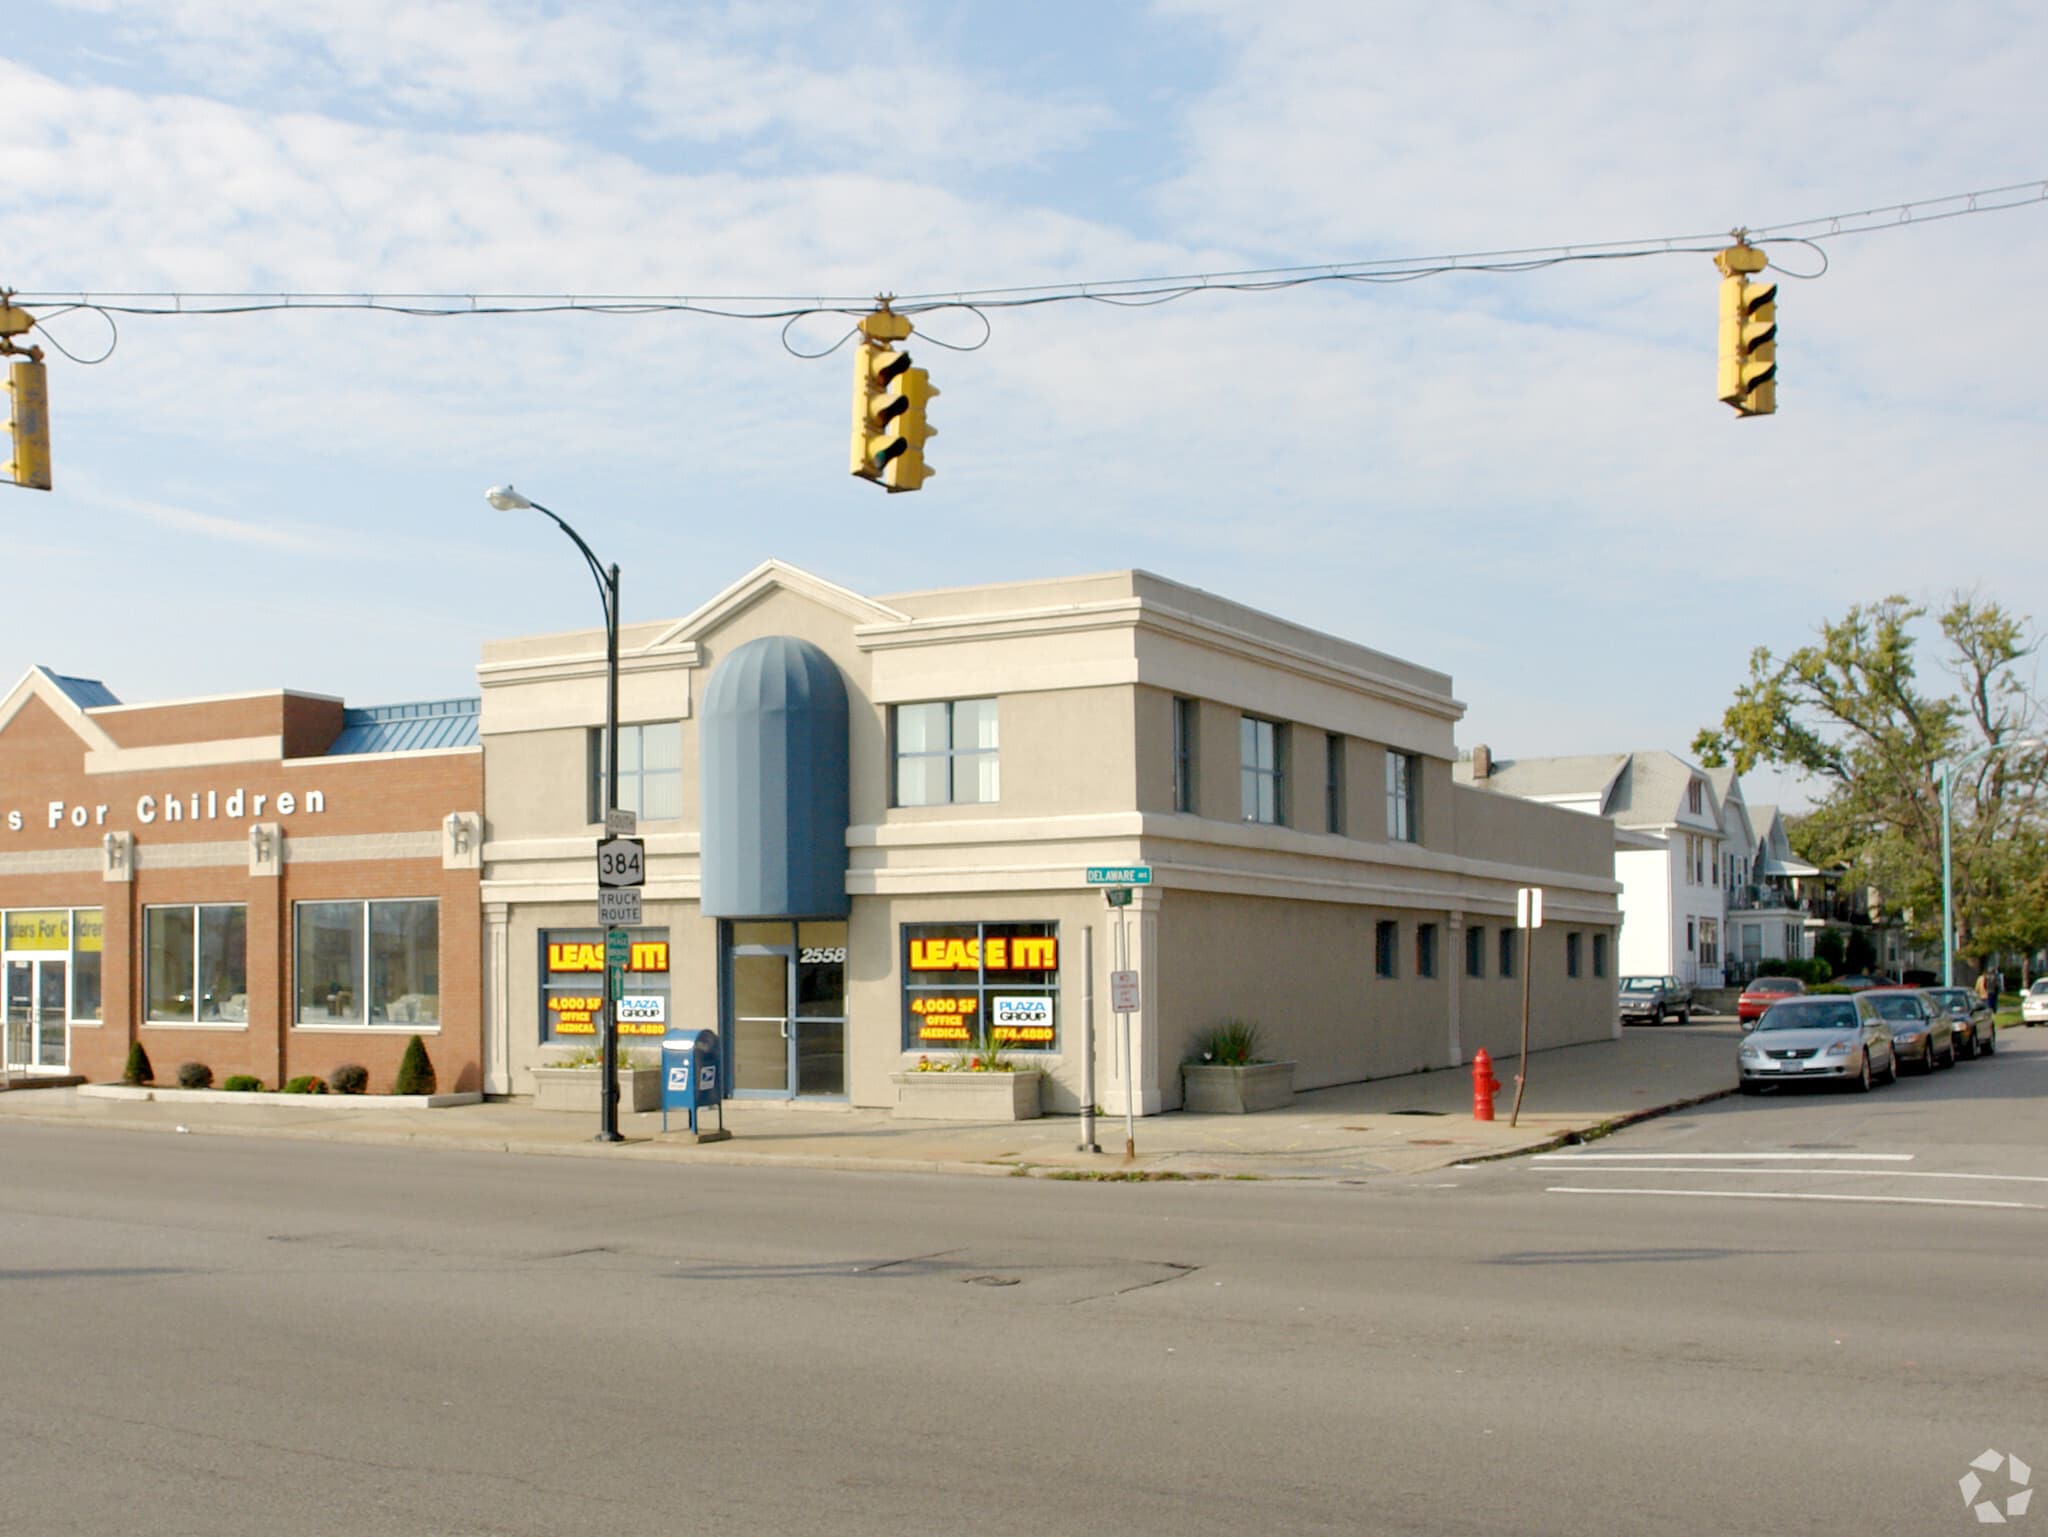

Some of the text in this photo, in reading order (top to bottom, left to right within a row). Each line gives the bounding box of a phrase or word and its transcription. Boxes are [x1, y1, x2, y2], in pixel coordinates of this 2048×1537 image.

[48, 801, 108, 828] For
[136, 788, 325, 824] Children
[602, 853, 640, 875] 384
[1088, 870, 1135, 882] DELAWARE
[601, 893, 639, 906] TRUCK
[601, 908, 640, 921] ROUTE
[39, 919, 57, 938] For
[548, 942, 629, 973] LEAS
[631, 941, 670, 972] IT!
[800, 948, 847, 963] 2558
[909, 937, 1059, 971] LEASE IT!
[548, 997, 603, 1011] 4,000 SF
[621, 1000, 660, 1008] PLAZA
[911, 999, 977, 1013] 4,000 SF
[999, 1001, 1046, 1011] PLAZA
[560, 1011, 591, 1021] OFFICE
[622, 1009, 660, 1018] GROUP
[1000, 1012, 1046, 1021] GROUP
[925, 1015, 963, 1026] OFFICE
[555, 1023, 596, 1033] MEDICAL
[919, 1028, 970, 1039] MEDICAL
